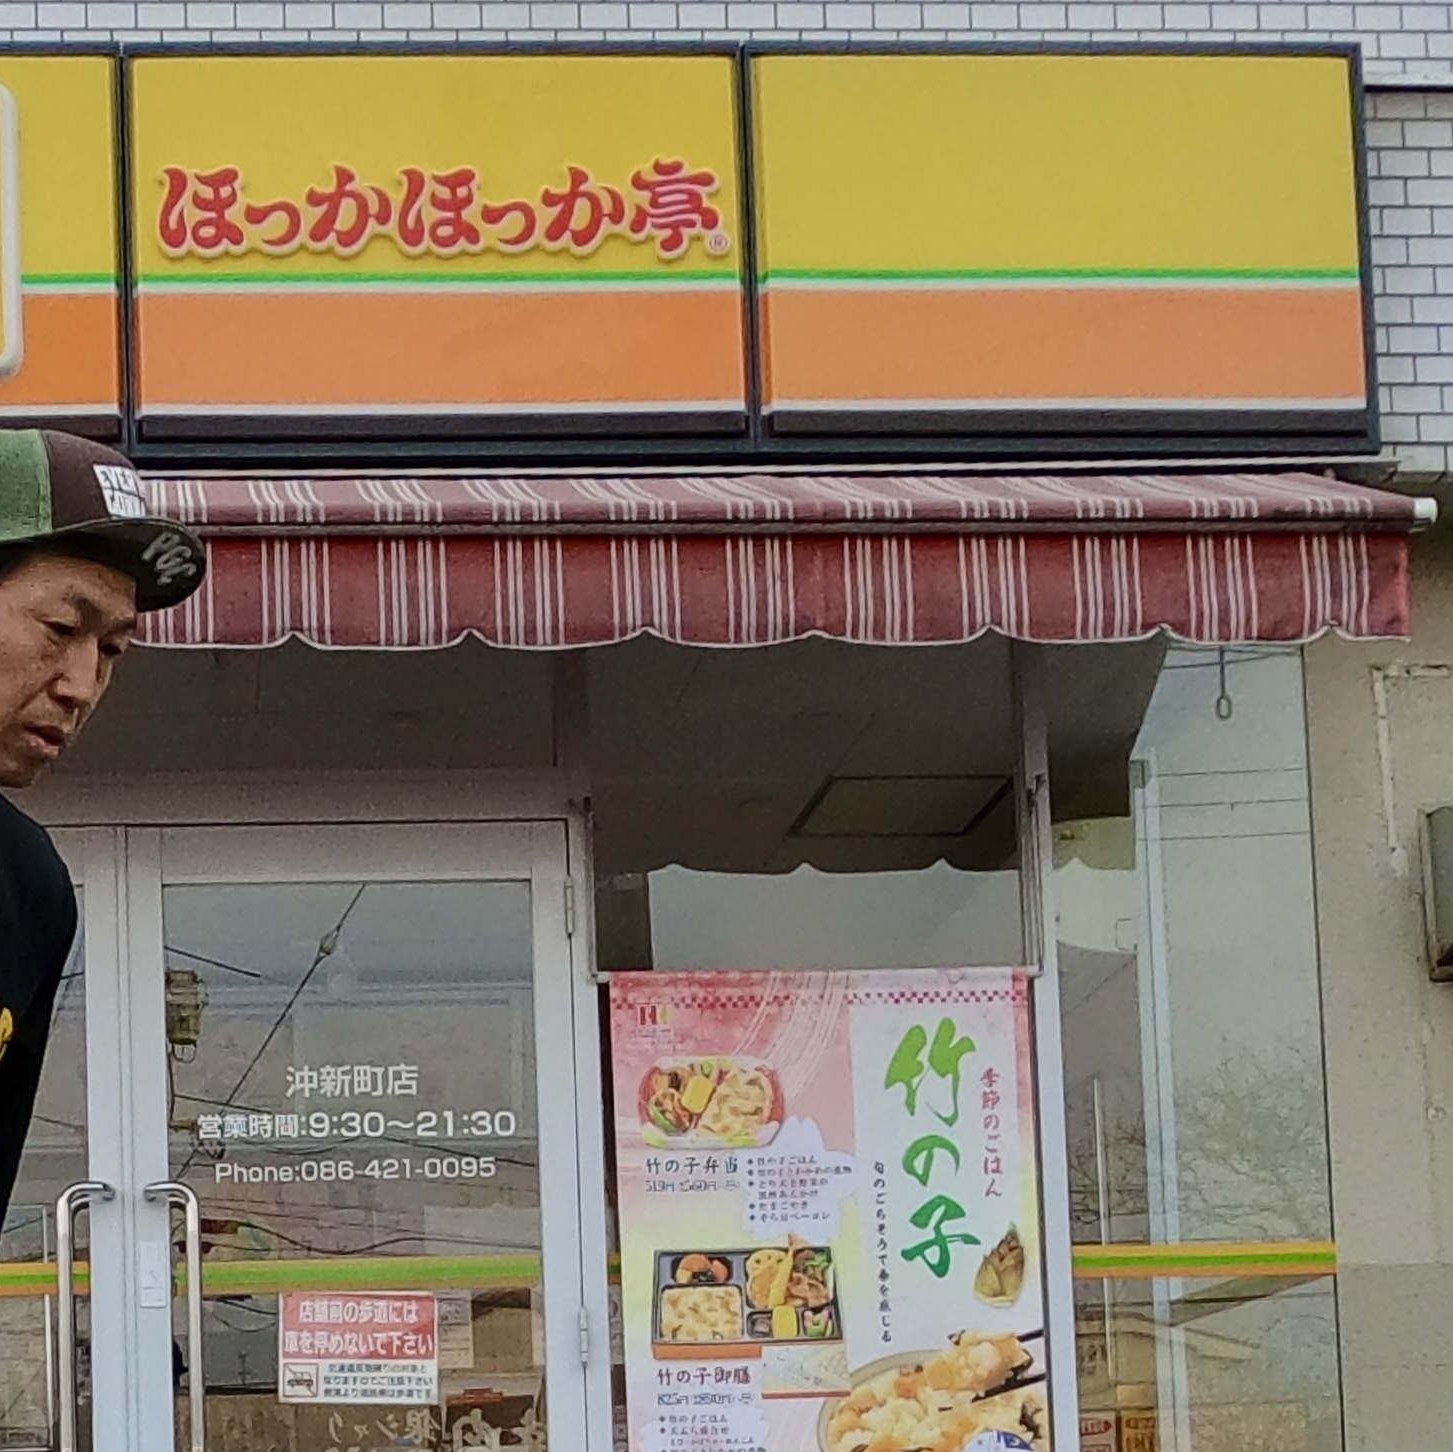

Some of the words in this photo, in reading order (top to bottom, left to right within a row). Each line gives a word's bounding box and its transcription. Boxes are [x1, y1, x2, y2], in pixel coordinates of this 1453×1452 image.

[159, 157, 719, 252] ほっかほっか亭
[285, 1064, 419, 1099] 沖新町店
[884, 1017, 981, 1279] 竹の子
[979, 1066, 1004, 1198] 季節のごはん
[214, 1156, 497, 1184] Phone:086-421-0095
[645, 1156, 738, 1176] 竹の子弁当
[656, 1366, 752, 1386] 竹の子御膳
